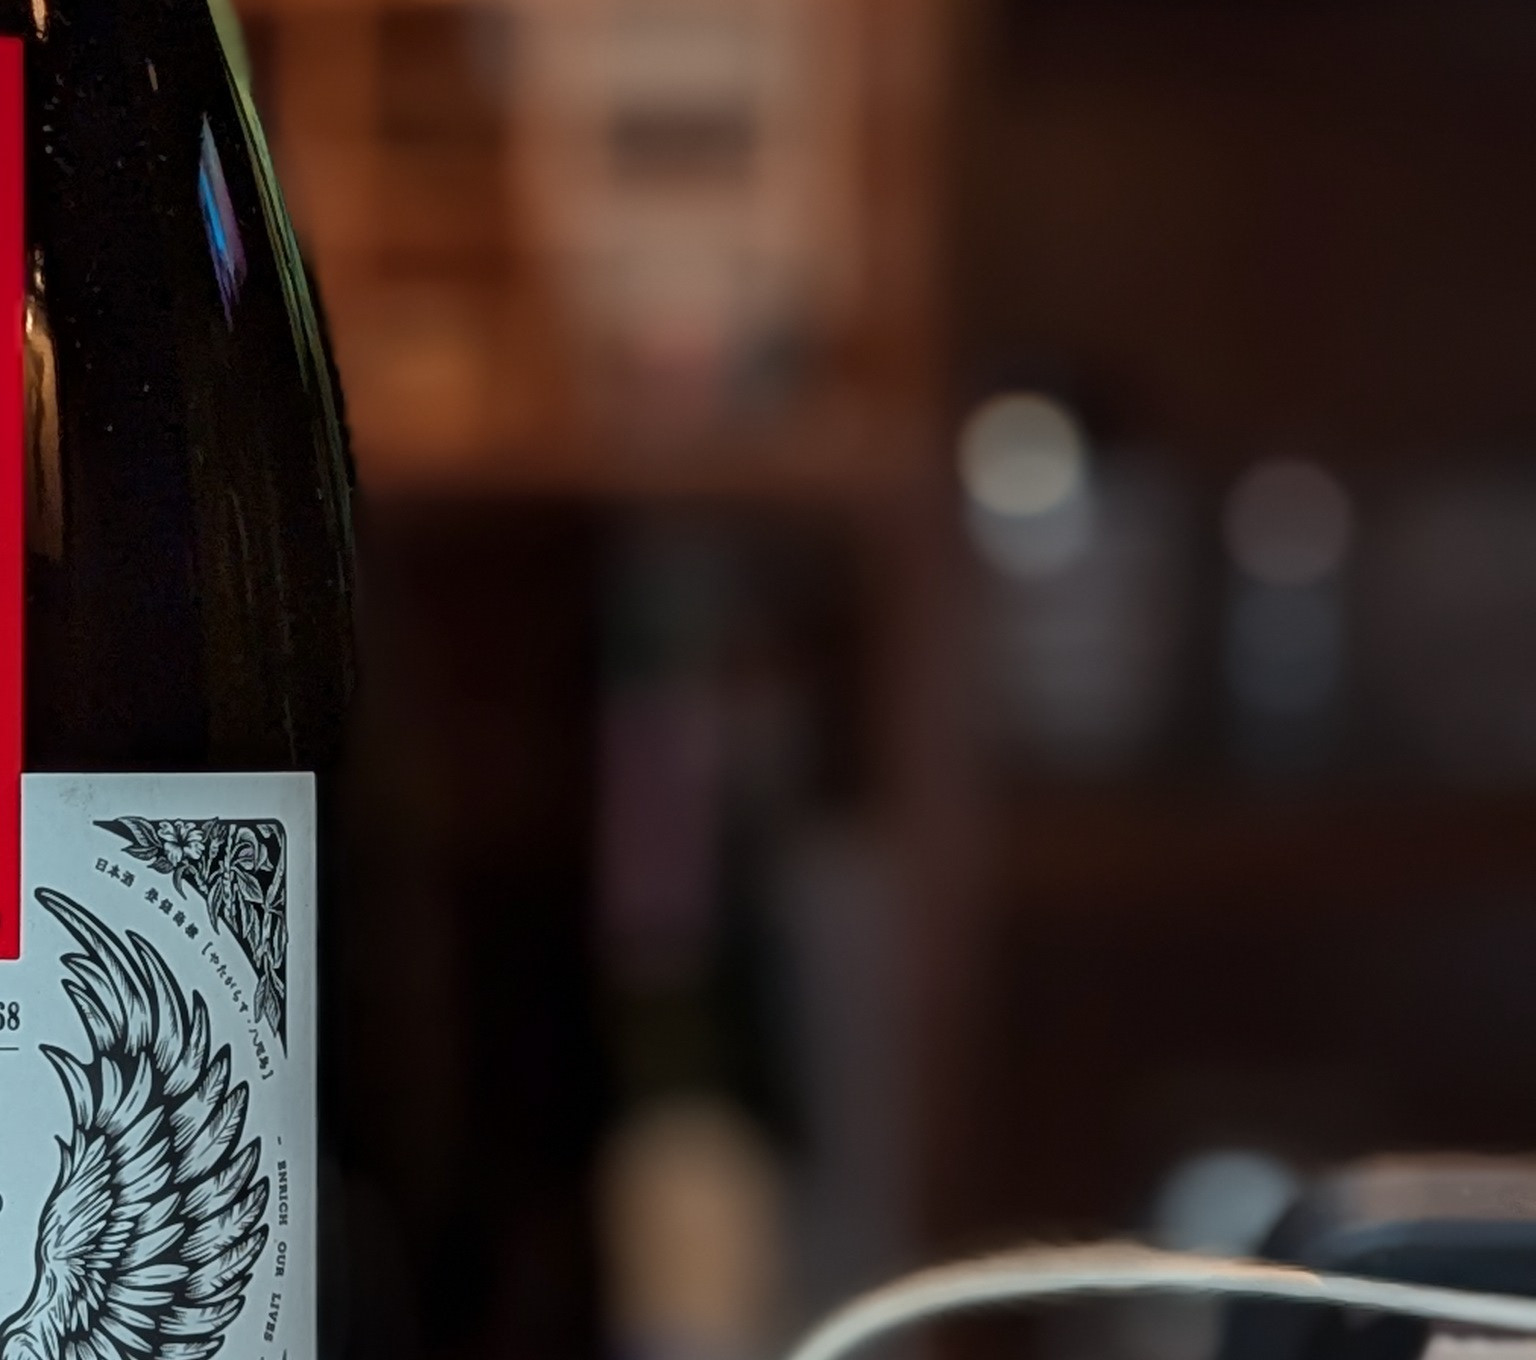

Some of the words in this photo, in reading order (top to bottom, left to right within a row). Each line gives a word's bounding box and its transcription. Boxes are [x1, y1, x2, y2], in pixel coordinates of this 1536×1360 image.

[94, 857, 136, 888] 日本酒
[276, 1160, 289, 1227] ENRICH
[274, 1241, 288, 1278] OUR
[264, 1292, 282, 1343] LIVES
